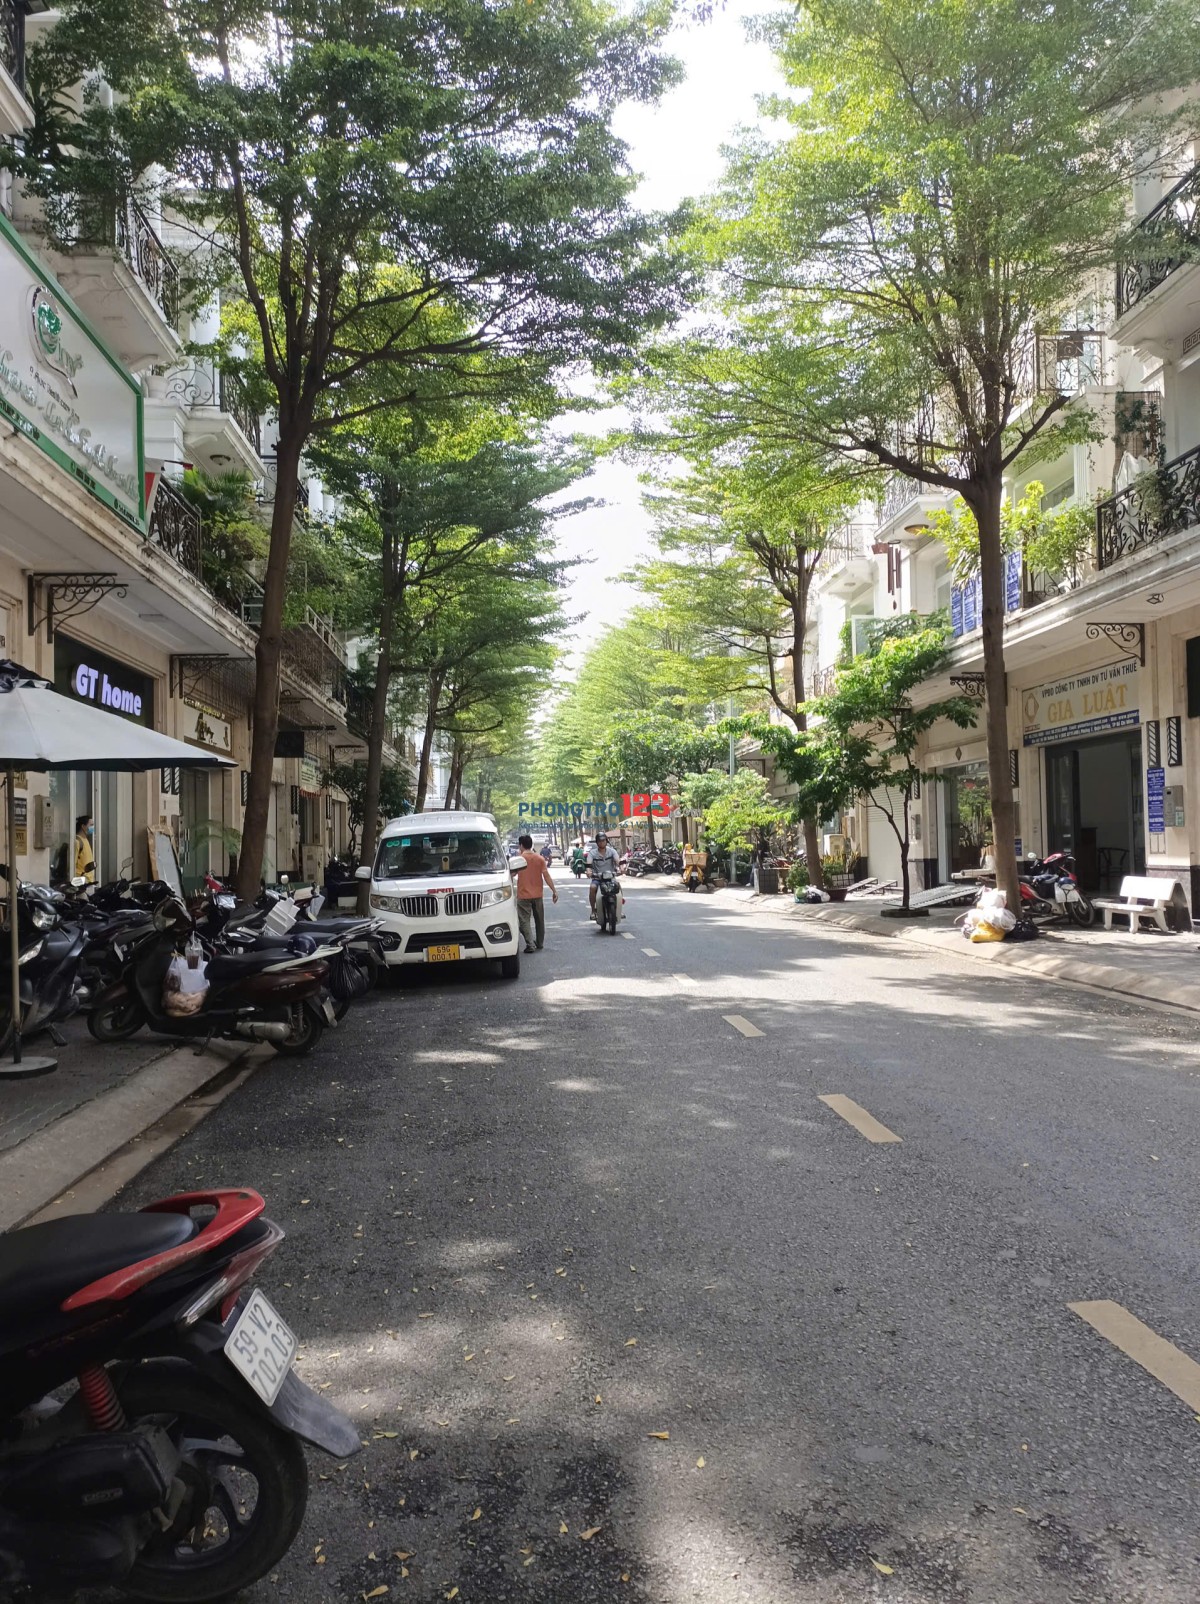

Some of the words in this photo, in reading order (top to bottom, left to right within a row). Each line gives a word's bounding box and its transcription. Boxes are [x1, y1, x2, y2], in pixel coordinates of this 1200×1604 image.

[75, 663, 98, 699] GT
[101, 674, 142, 716] home
[1047, 698, 1074, 723] GIA
[1082, 683, 1128, 716] LUẬT
[251, 1322, 293, 1400] 702.03
